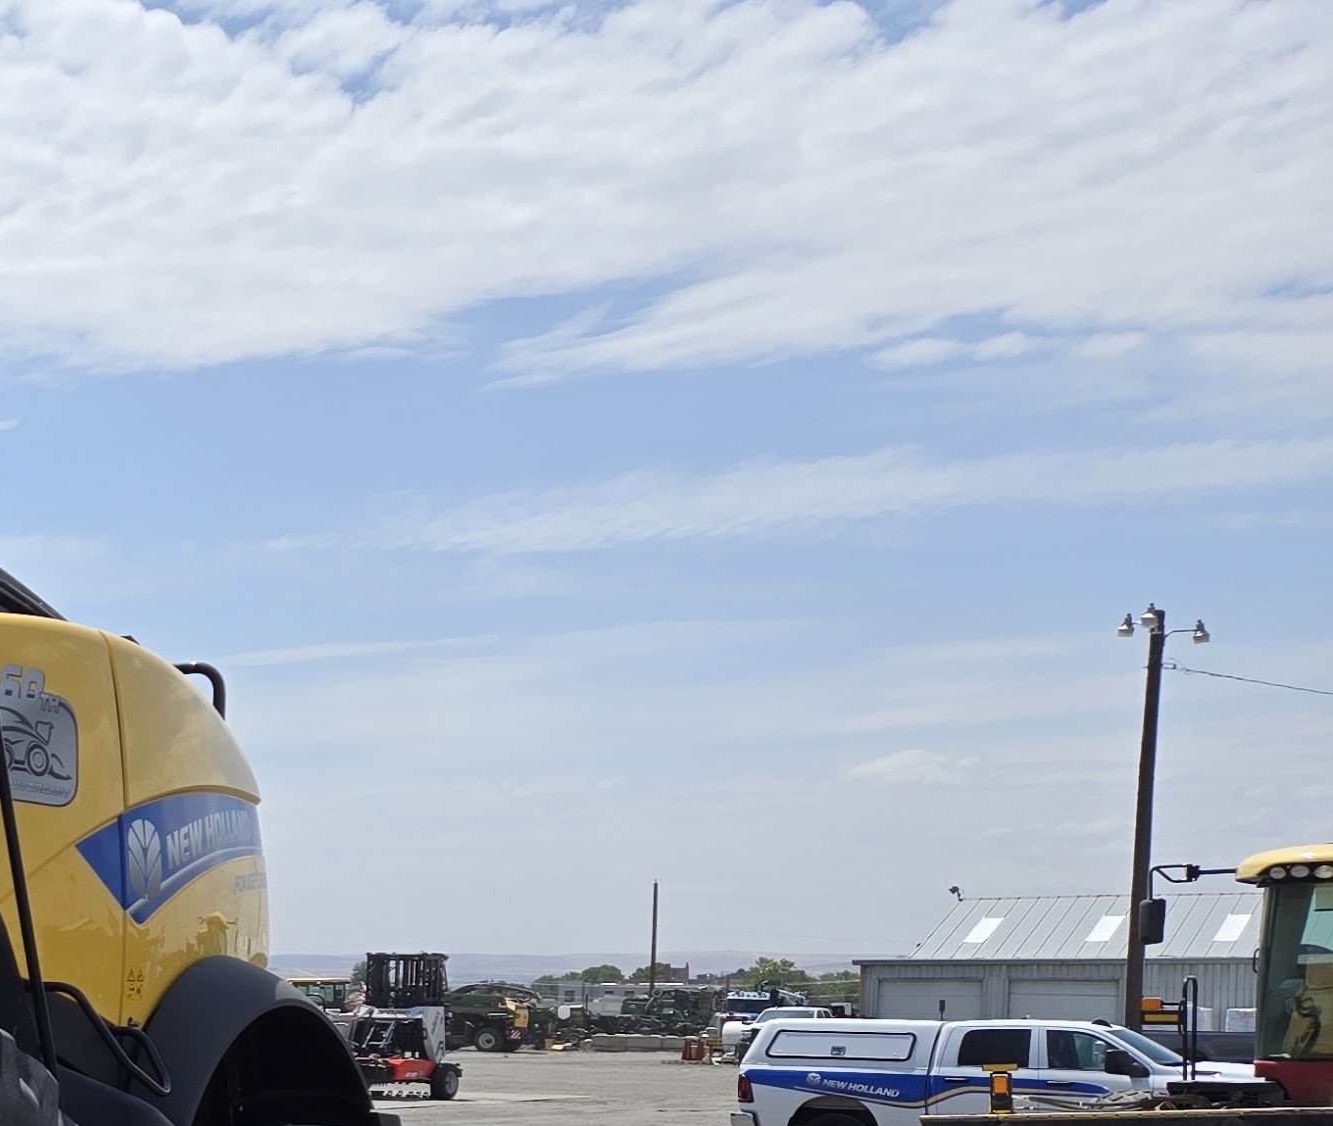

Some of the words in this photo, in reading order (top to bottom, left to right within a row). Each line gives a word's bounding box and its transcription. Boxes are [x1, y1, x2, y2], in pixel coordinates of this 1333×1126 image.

[165, 817, 203, 870] NEW
[204, 809, 251, 849] HOLLAND
[822, 1078, 848, 1090] NEW
[847, 1082, 900, 1098] HOLLAND
